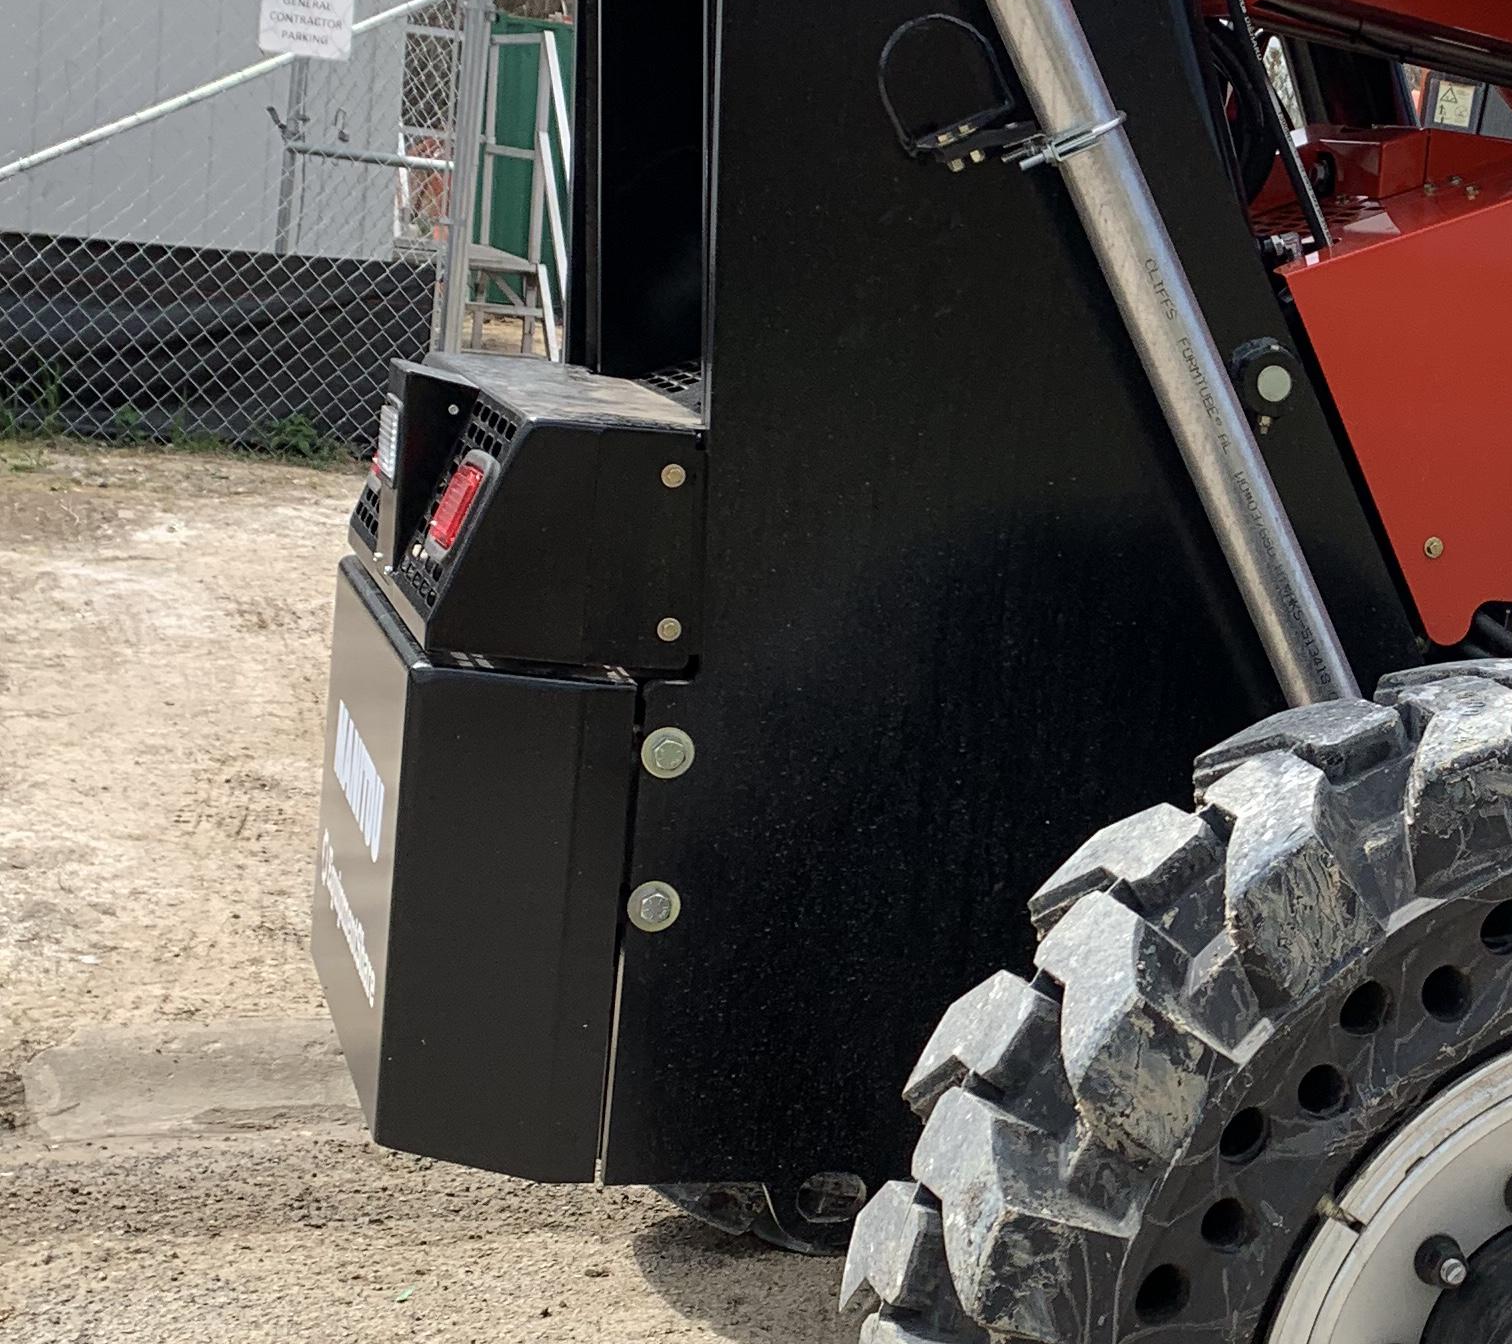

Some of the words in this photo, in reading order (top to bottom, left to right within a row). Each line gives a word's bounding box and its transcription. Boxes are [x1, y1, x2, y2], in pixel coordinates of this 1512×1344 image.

[270, 11, 342, 29] CONTRACTOR
[281, 30, 328, 45] PARKING
[1144, 257, 1178, 321] CLIFFS
